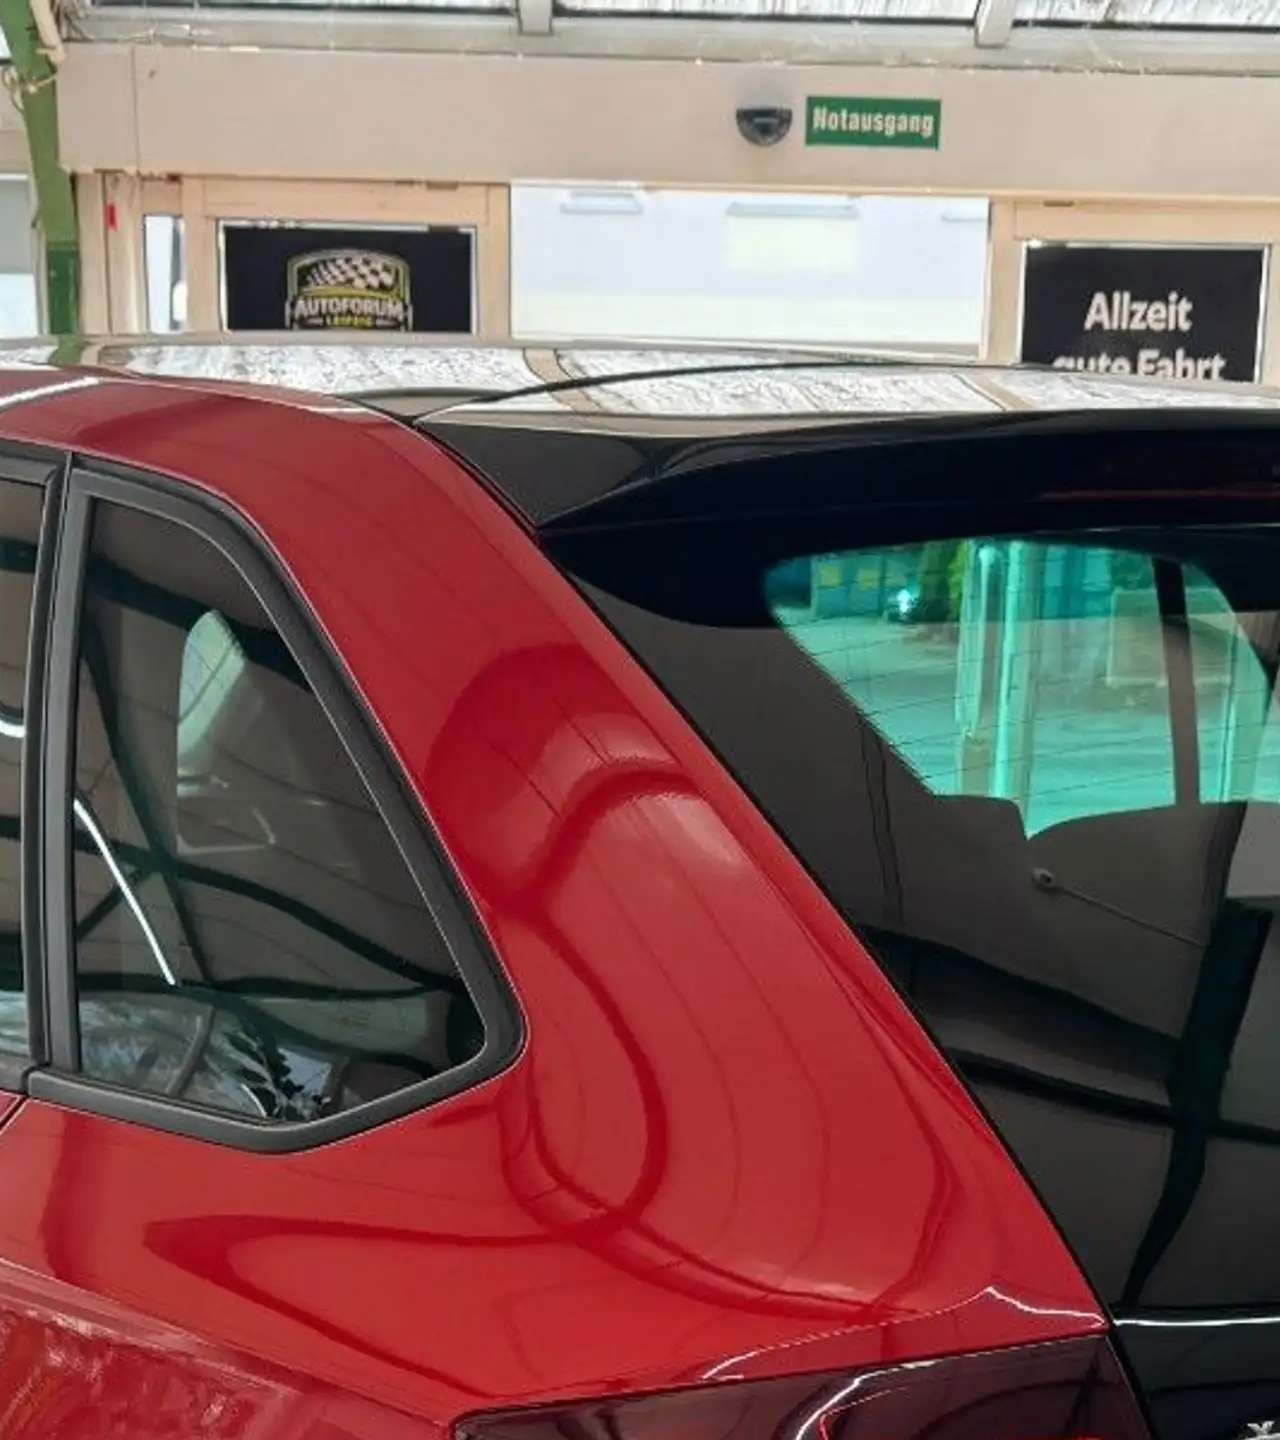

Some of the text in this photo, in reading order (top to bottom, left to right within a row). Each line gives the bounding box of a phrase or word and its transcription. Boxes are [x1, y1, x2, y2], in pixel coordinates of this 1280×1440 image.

[812, 105, 934, 138] Notausgang
[294, 296, 405, 321] AUTOFORUM
[1083, 290, 1193, 332] Allzeit
[1136, 347, 1226, 380] Fahrt
